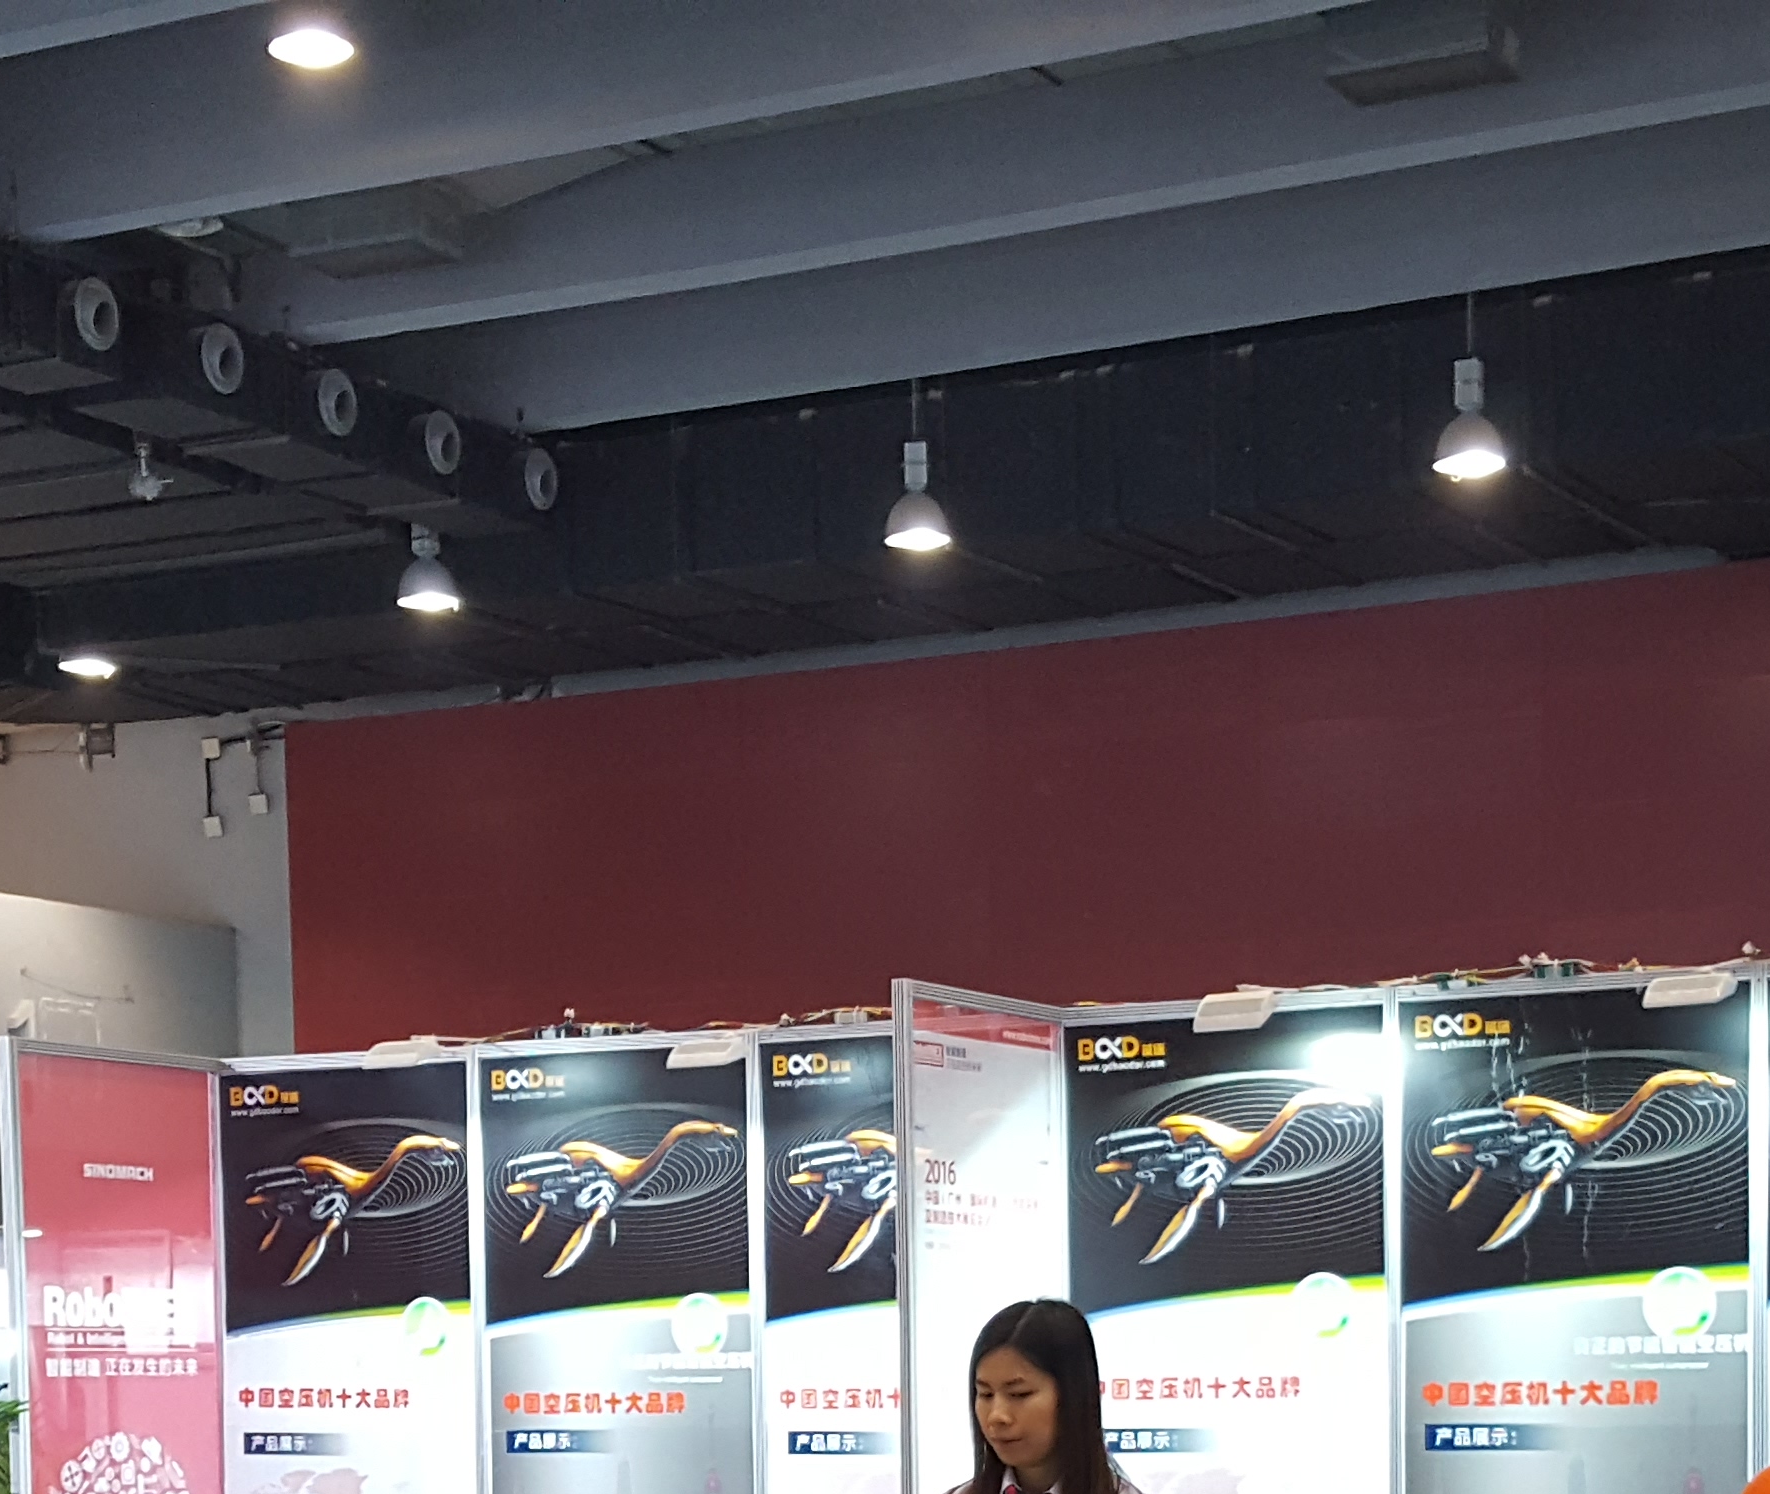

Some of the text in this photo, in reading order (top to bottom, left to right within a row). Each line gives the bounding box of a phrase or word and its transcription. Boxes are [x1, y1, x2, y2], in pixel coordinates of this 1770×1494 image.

[925, 1159, 957, 1186] 2016
[239, 1387, 410, 1409] 中国空压机十大品牌
[503, 1391, 686, 1415] 中国空压机十大品牌
[1422, 1380, 1659, 1407] 中国空压机十大品牌
